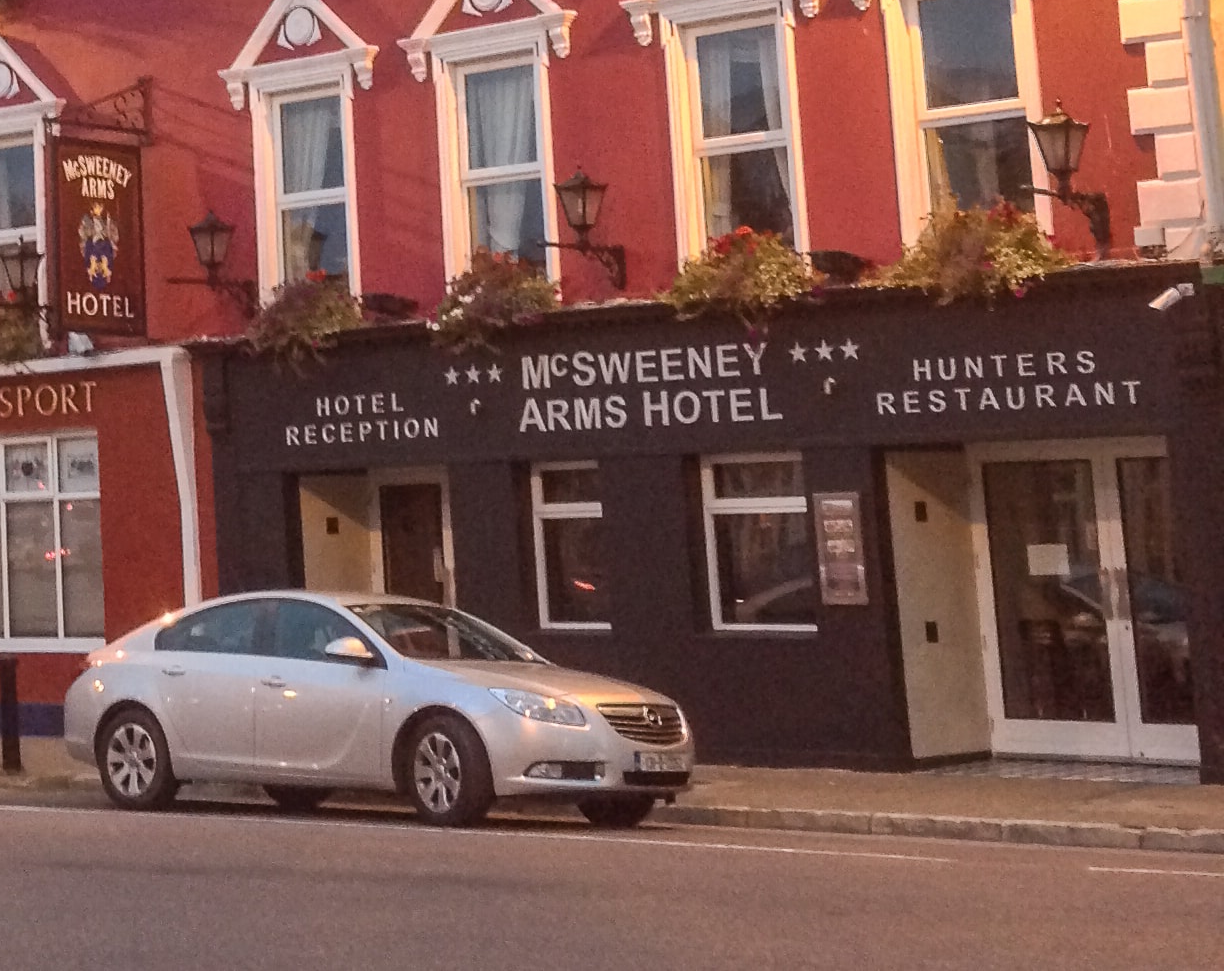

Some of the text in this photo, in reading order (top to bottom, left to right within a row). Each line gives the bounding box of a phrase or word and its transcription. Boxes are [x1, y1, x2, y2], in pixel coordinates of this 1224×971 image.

[62, 154, 132, 188] McSWEENEY
[81, 178, 115, 200] ARMS
[66, 291, 135, 318] HOTEL
[521, 342, 767, 390] McSWEENEY
[913, 350, 1096, 381] HUNTERS
[316, 392, 404, 417] HOTEL
[519, 388, 783, 433] ARMS HOTEL
[876, 380, 1140, 415] RESTAURANT
[285, 417, 439, 446] RECEPTION
